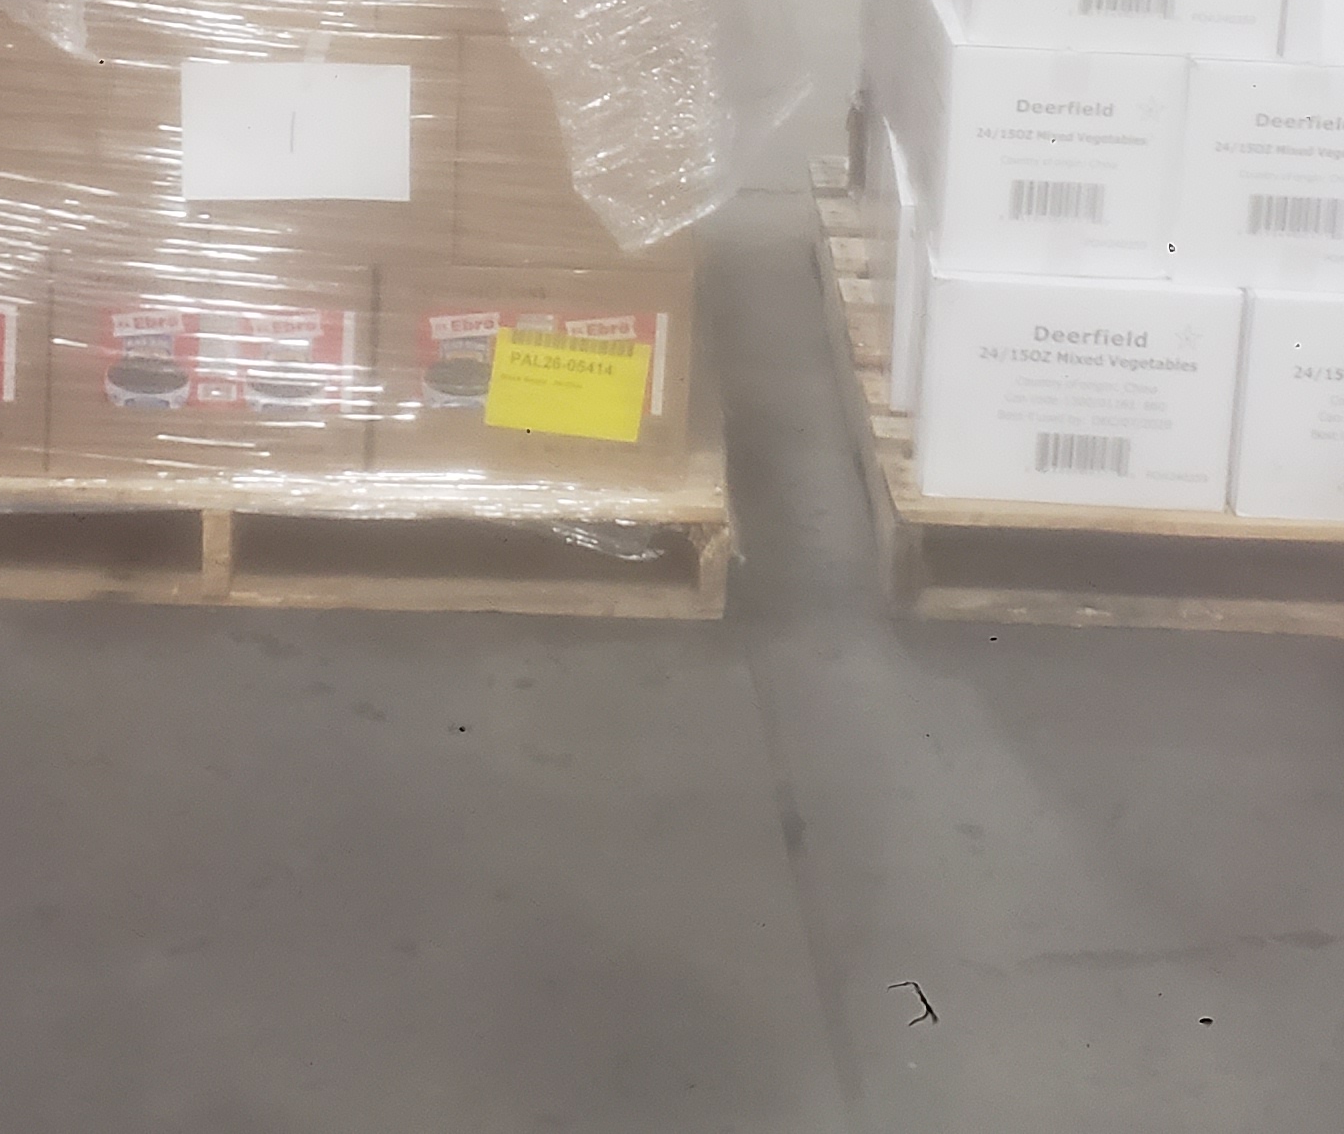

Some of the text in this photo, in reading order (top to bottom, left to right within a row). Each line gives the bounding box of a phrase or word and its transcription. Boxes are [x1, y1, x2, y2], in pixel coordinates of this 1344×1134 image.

[1016, 99, 1114, 117] Deerfield
[1036, 130, 1074, 142] Mixed
[1077, 133, 1147, 145] Vegetables
[1276, 145, 1315, 156] Mixed
[133, 318, 178, 329] Ebro
[452, 320, 494, 332] Ebro
[587, 323, 630, 335] Ebro
[1034, 326, 1148, 348] Deerfield
[979, 347, 1198, 371] 24/15OZ Mixed Vegetables
